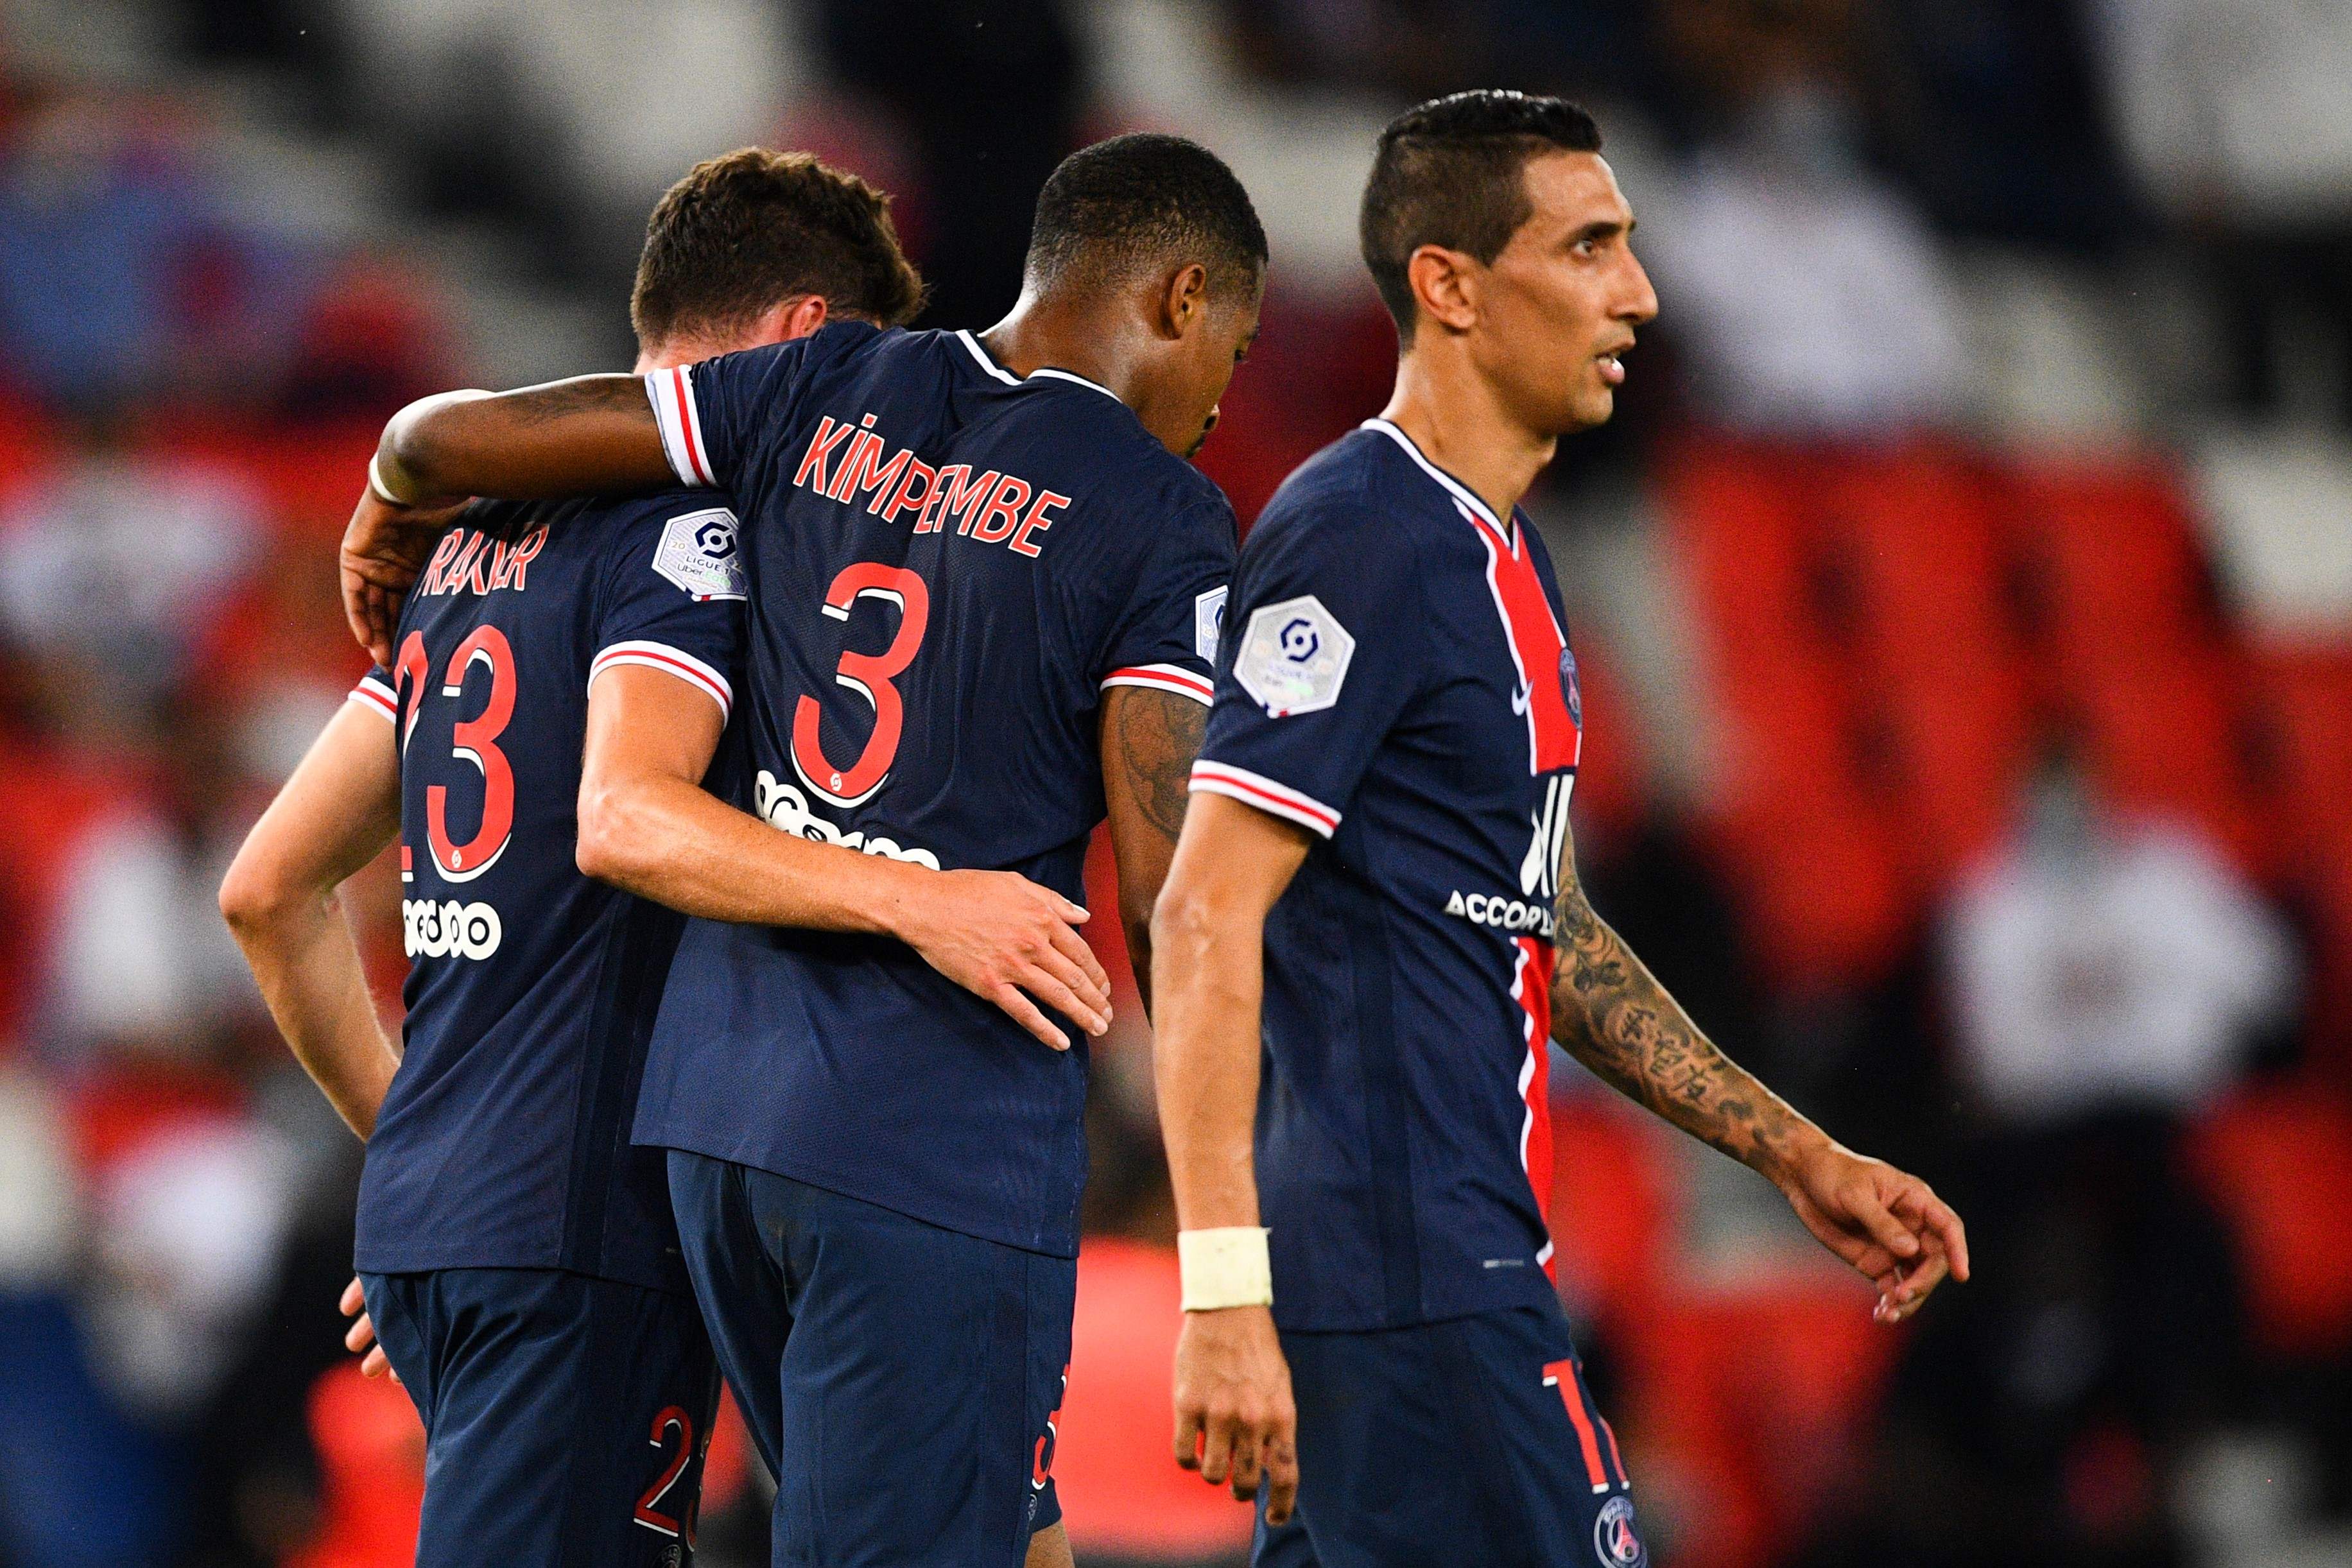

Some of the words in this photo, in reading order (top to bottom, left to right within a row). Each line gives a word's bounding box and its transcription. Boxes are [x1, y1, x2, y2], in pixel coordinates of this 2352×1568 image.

[677, 564, 702, 576] Uber
[686, 555, 722, 571] LIGUE
[791, 562, 929, 809] 3
